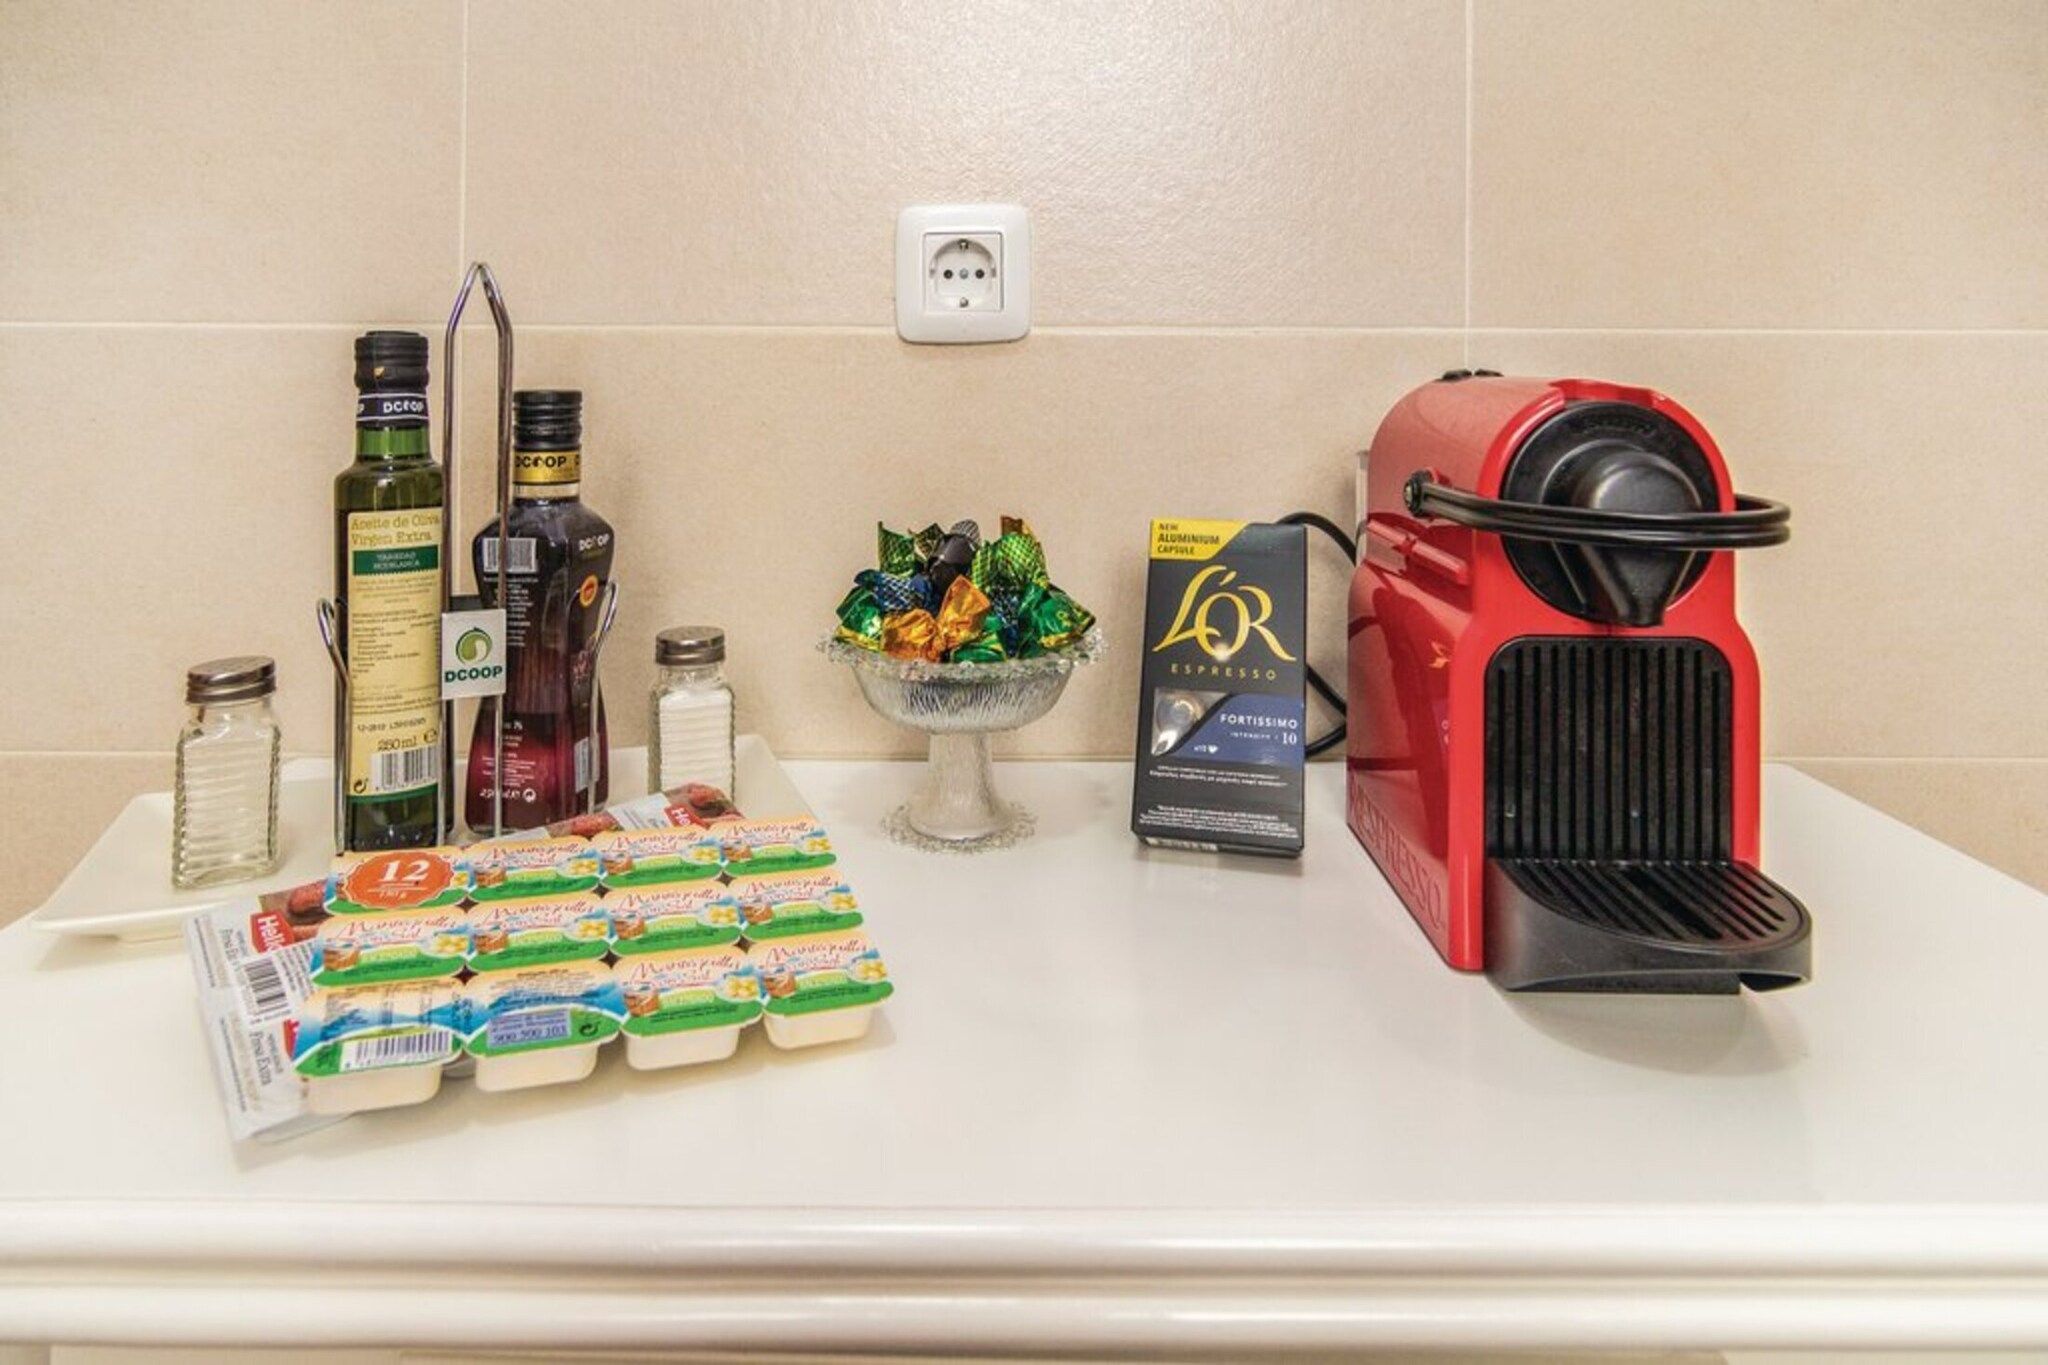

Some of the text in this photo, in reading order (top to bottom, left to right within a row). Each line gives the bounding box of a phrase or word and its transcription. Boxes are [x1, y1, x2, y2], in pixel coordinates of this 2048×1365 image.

[392, 516, 409, 528] de
[1158, 533, 1220, 545] ALUMINIUM
[1157, 545, 1195, 555] CAPSULE
[444, 665, 503, 683] DCOOP
[1170, 663, 1277, 681] ESPRESSO
[1220, 713, 1298, 729] FORTISSIMO
[1282, 732, 1297, 745] 10
[380, 859, 430, 881] 12
